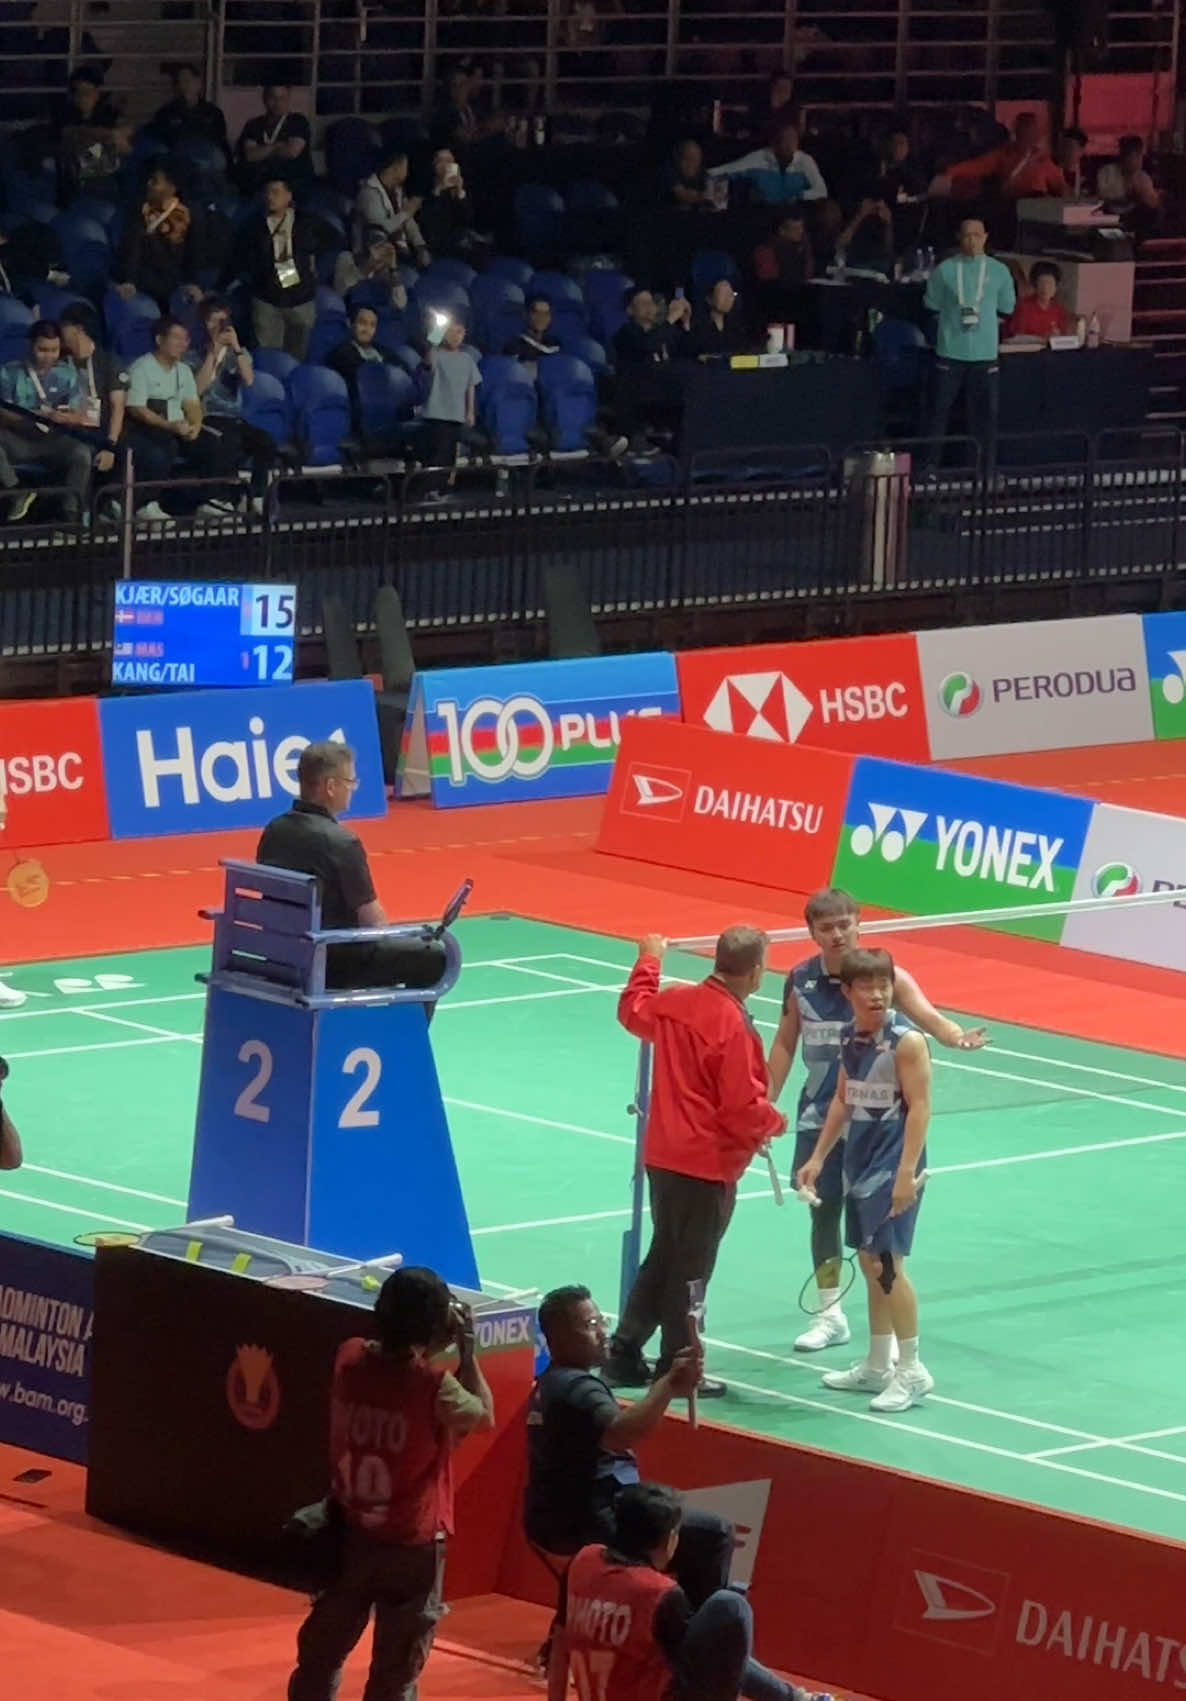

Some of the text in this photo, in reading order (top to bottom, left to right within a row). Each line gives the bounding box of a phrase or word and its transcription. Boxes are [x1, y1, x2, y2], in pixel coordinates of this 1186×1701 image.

[255, 594, 295, 629] 15
[112, 661, 196, 683] KANG/TAI
[252, 644, 293, 680] 12
[819, 681, 909, 724] HSBC
[136, 716, 347, 808] Haie
[437, 695, 554, 784] 100
[693, 784, 824, 835] DAIHATSU
[935, 814, 1064, 893] YONEX
[234, 1039, 273, 1124] 2
[338, 1047, 382, 1129] 2
[0, 1284, 85, 1339] DMINTON
[0, 1322, 86, 1377] MALAYSIA
